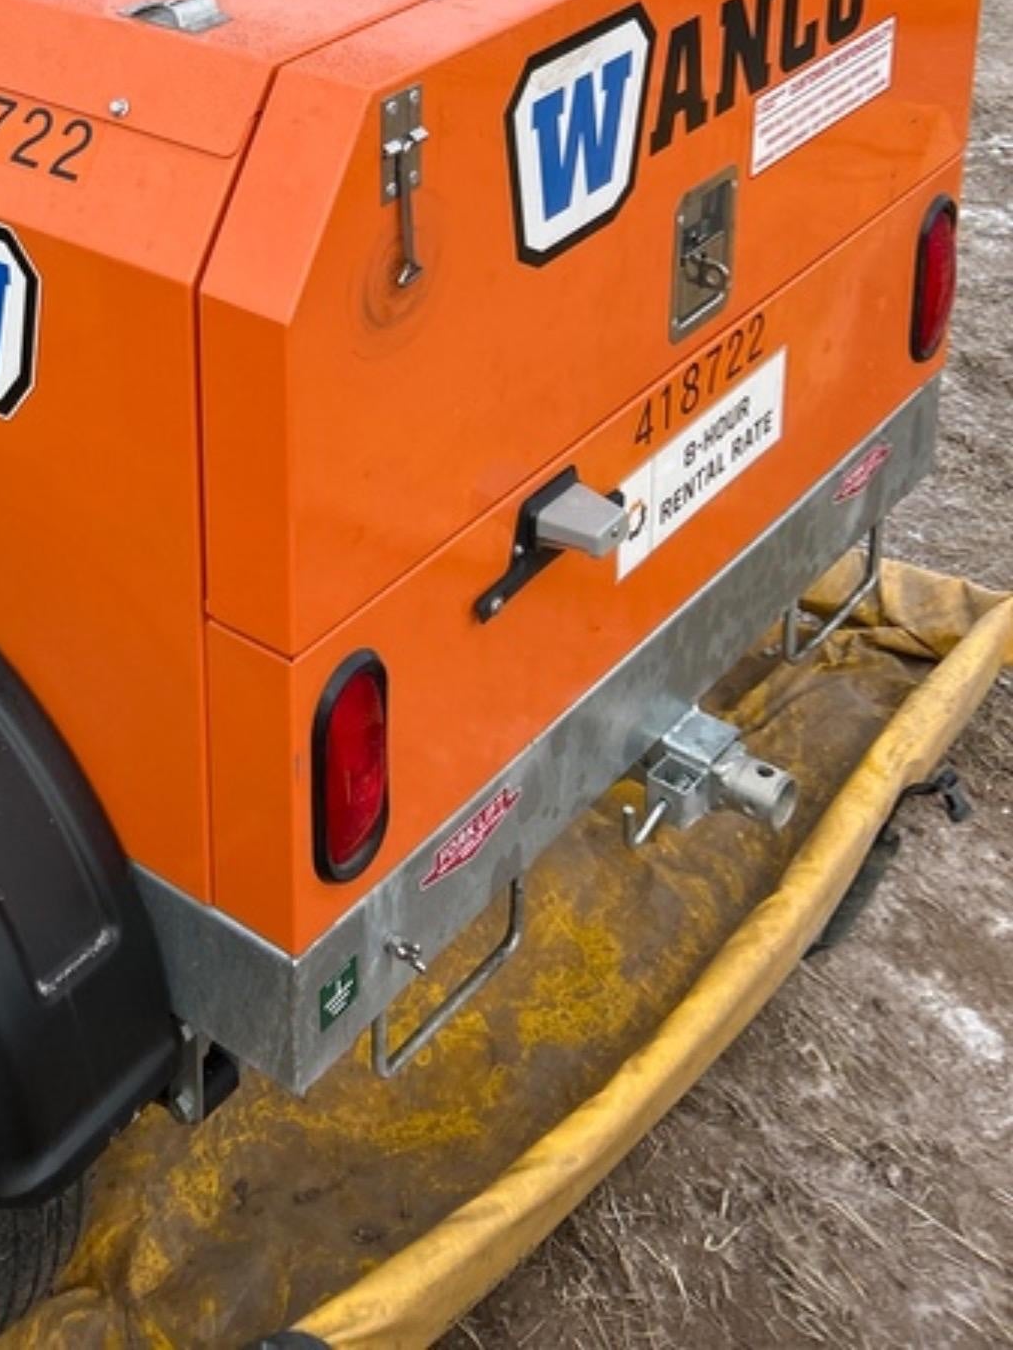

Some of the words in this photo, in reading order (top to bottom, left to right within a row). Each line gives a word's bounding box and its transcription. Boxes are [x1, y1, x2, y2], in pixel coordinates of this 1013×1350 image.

[634, 312, 766, 444] 418722
[683, 395, 750, 467] 8-HOUR
[659, 453, 725, 525] RENTAL
[731, 410, 774, 462] RATE
